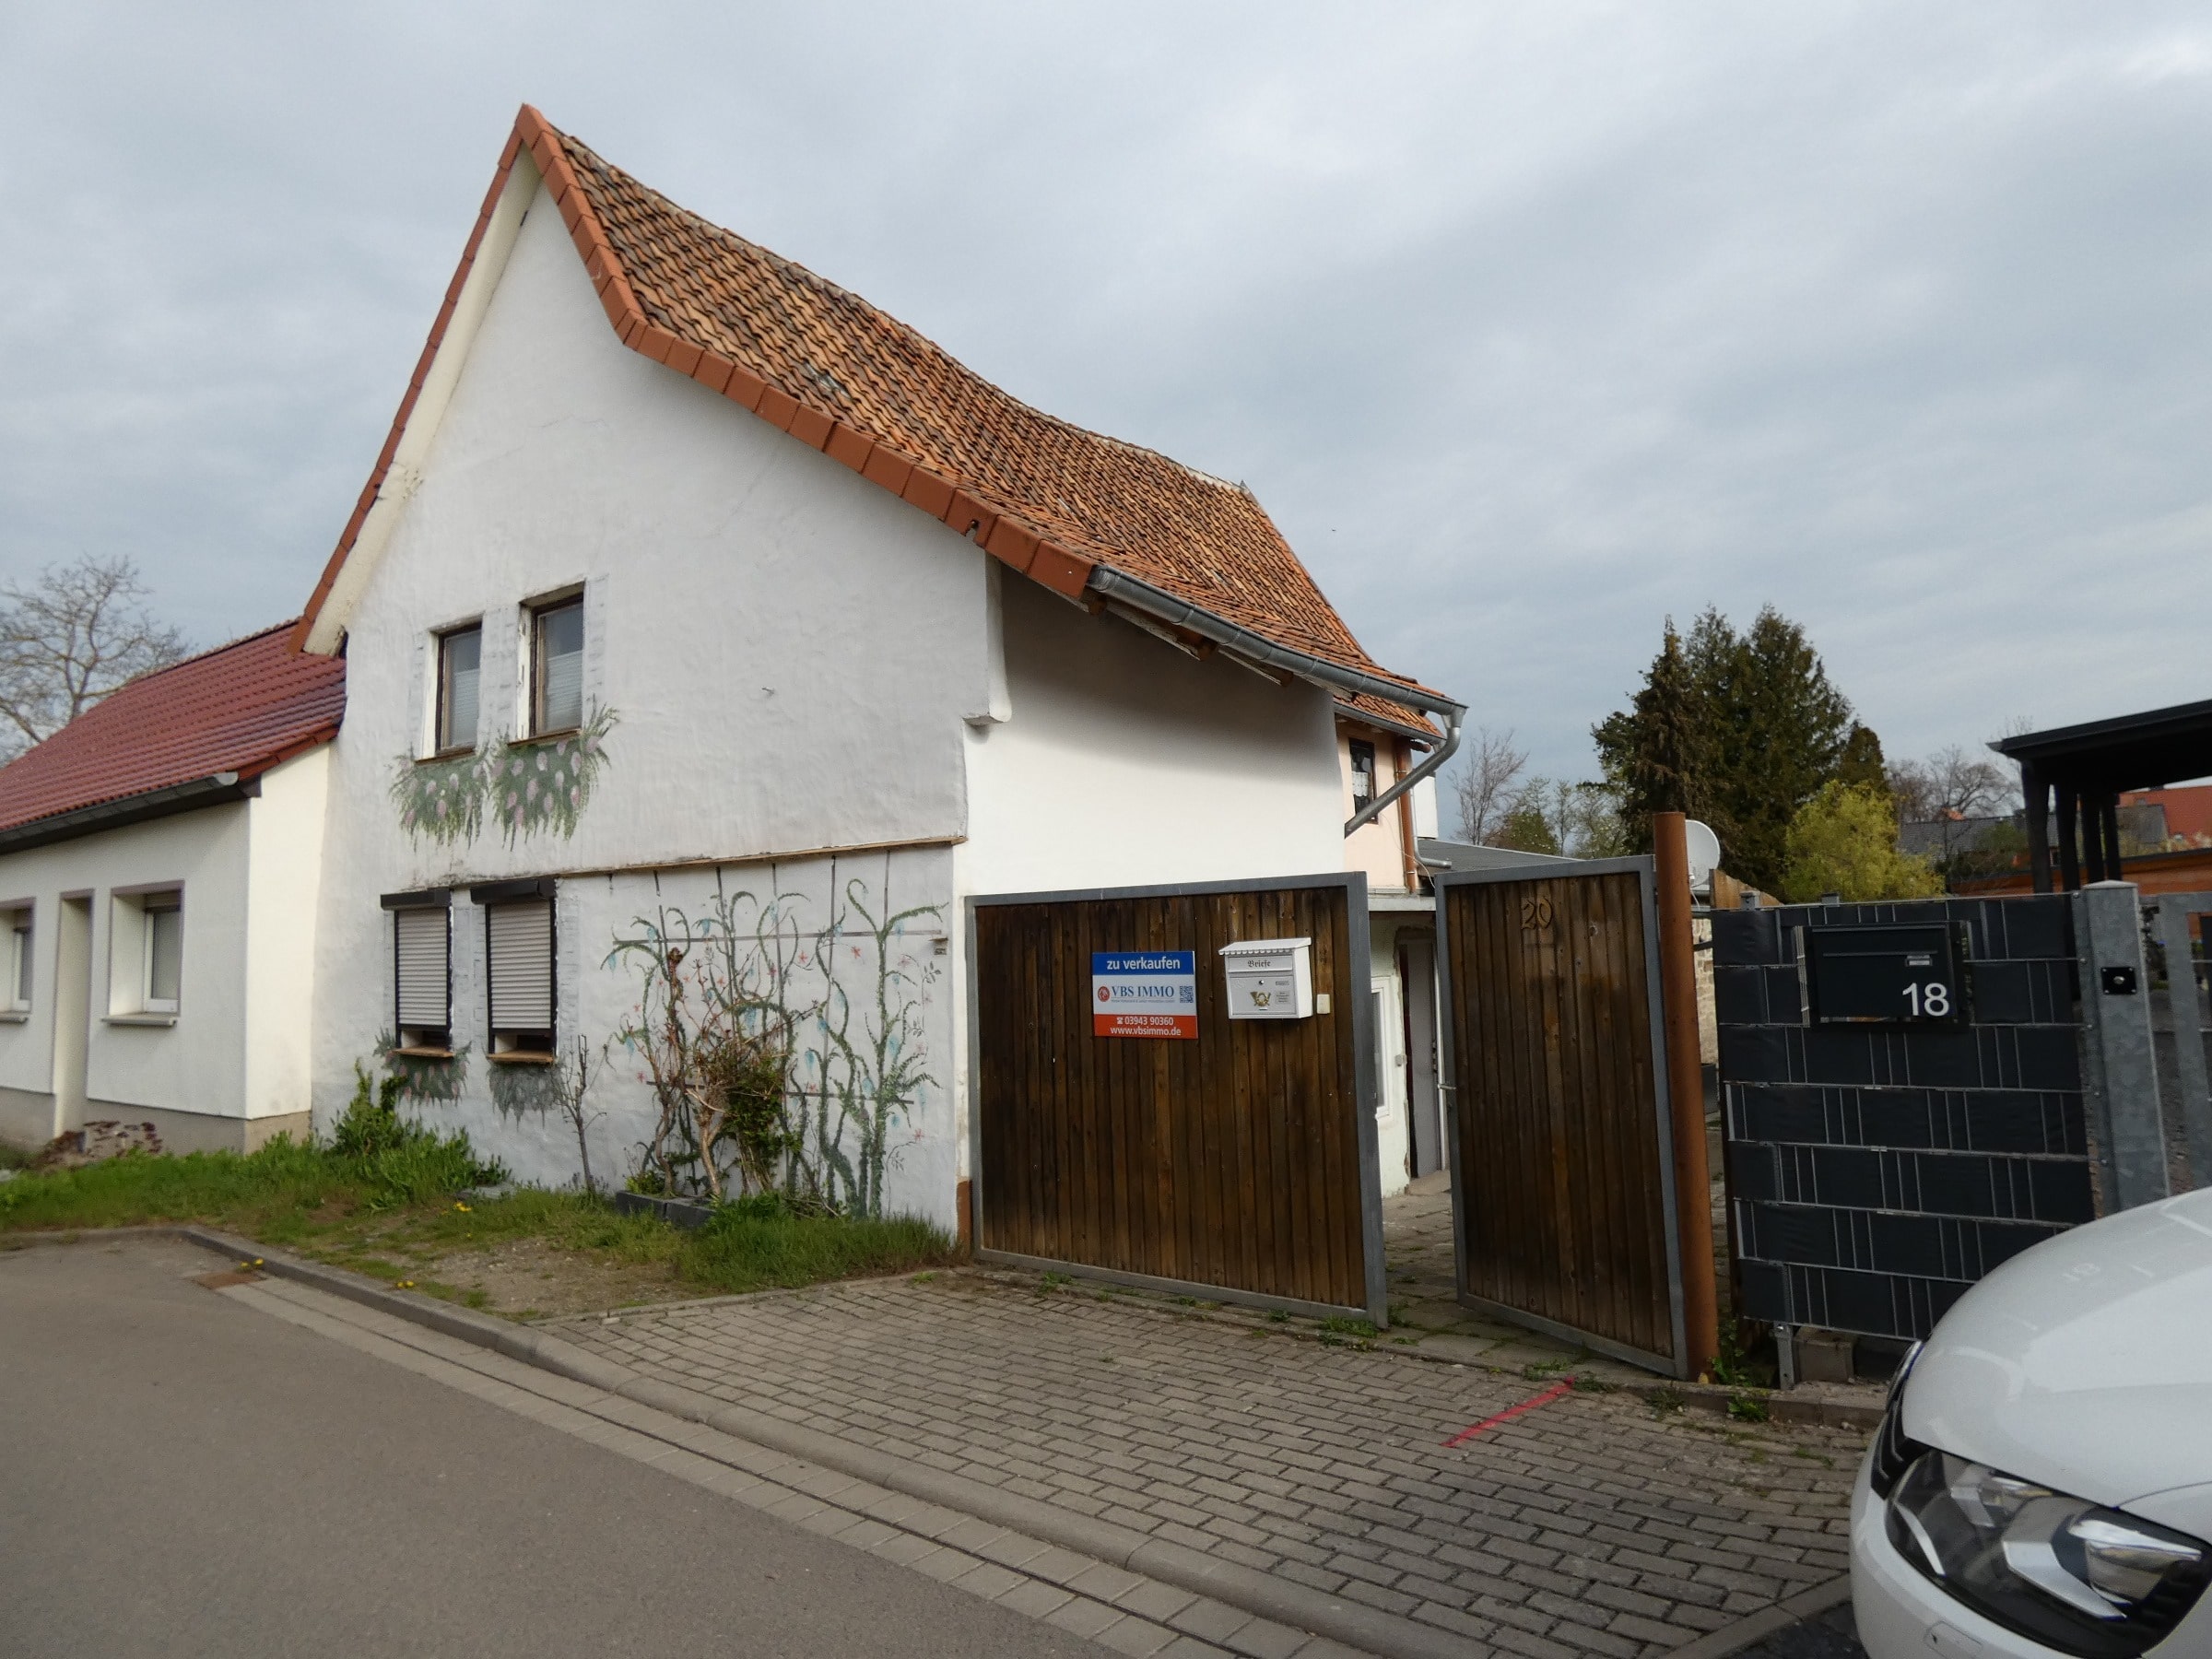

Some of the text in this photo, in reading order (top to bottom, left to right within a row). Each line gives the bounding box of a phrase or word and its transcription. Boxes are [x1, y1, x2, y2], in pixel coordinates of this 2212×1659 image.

[1522, 895, 1553, 931] 20
[1107, 956, 1181, 971] zu verkaufen
[1248, 959, 1271, 968] Briefe
[1112, 985, 1174, 998] VBS IMMO
[1902, 982, 1949, 1017] 18
[1124, 1017, 1174, 1026] 03943 90360
[1110, 1026, 1182, 1036] www.vbsimmo.de
